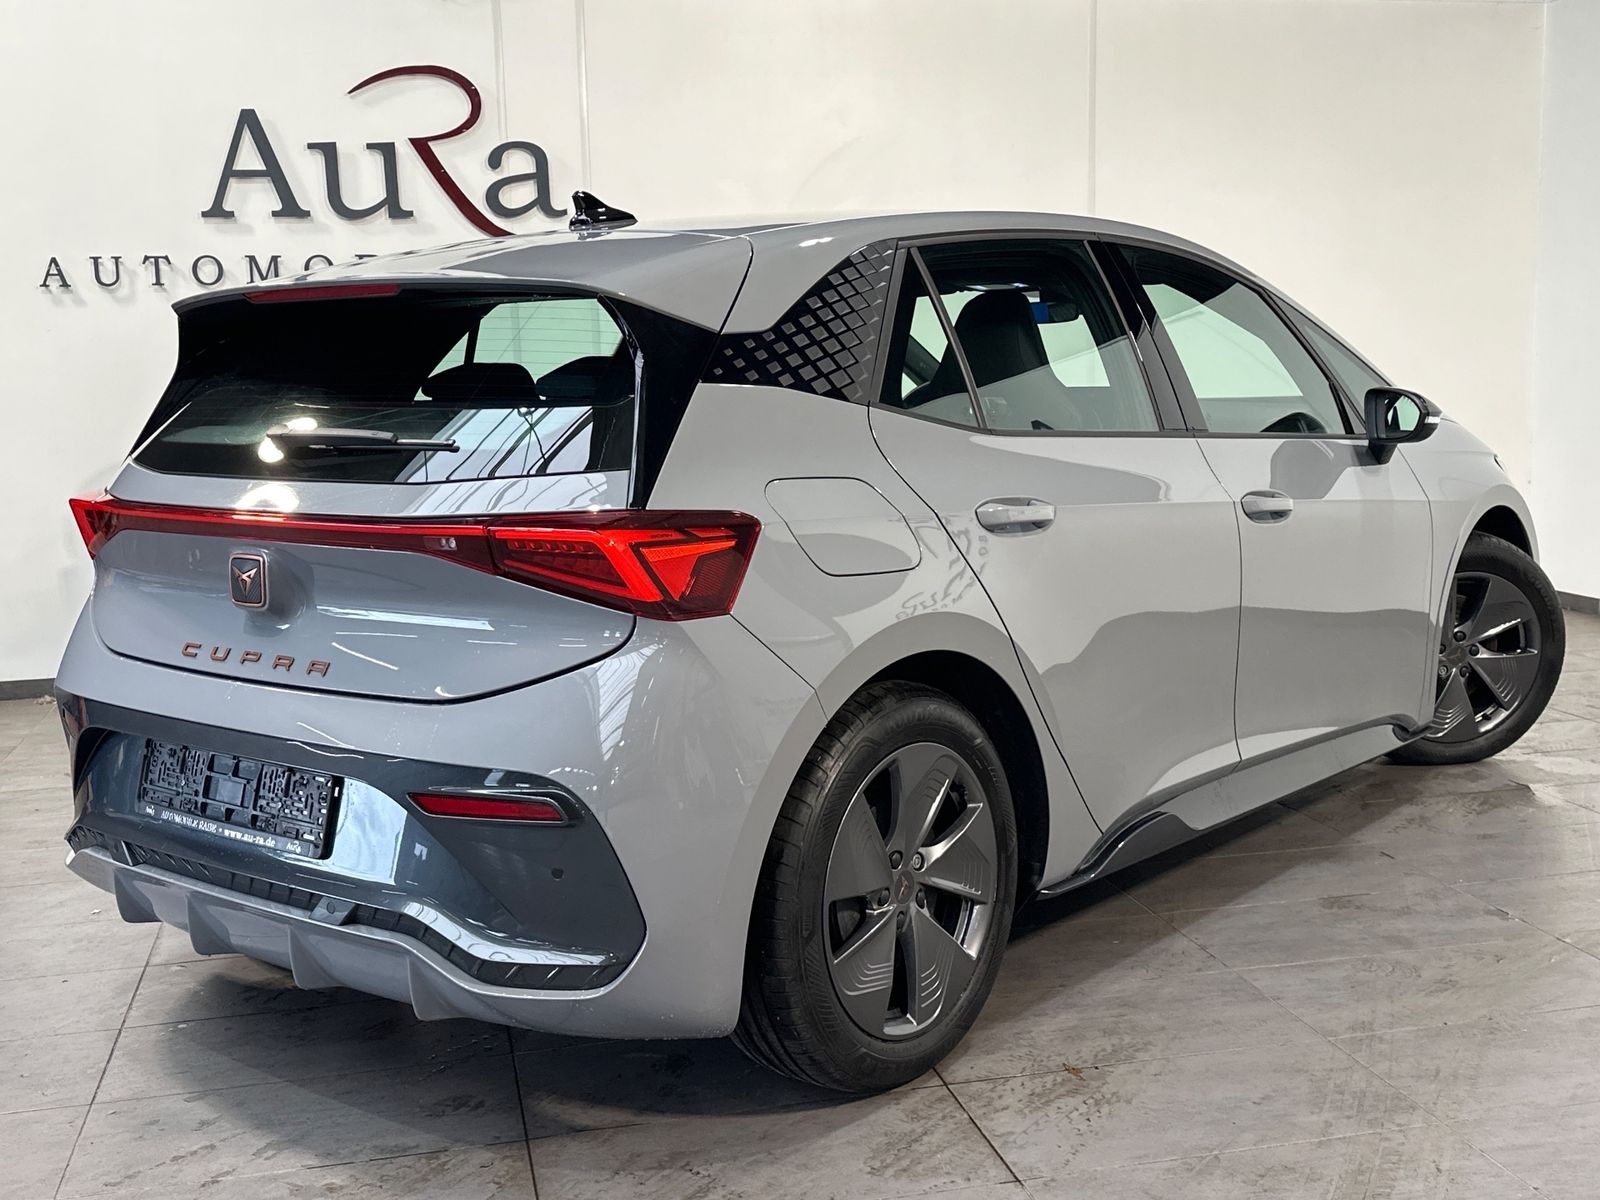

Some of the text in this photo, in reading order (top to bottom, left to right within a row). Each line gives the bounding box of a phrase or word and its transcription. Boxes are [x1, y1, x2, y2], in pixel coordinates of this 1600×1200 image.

[200, 64, 568, 237] AuRa
[181, 641, 331, 678] CUPRA
[223, 827, 276, 848] www.au-ra.de
